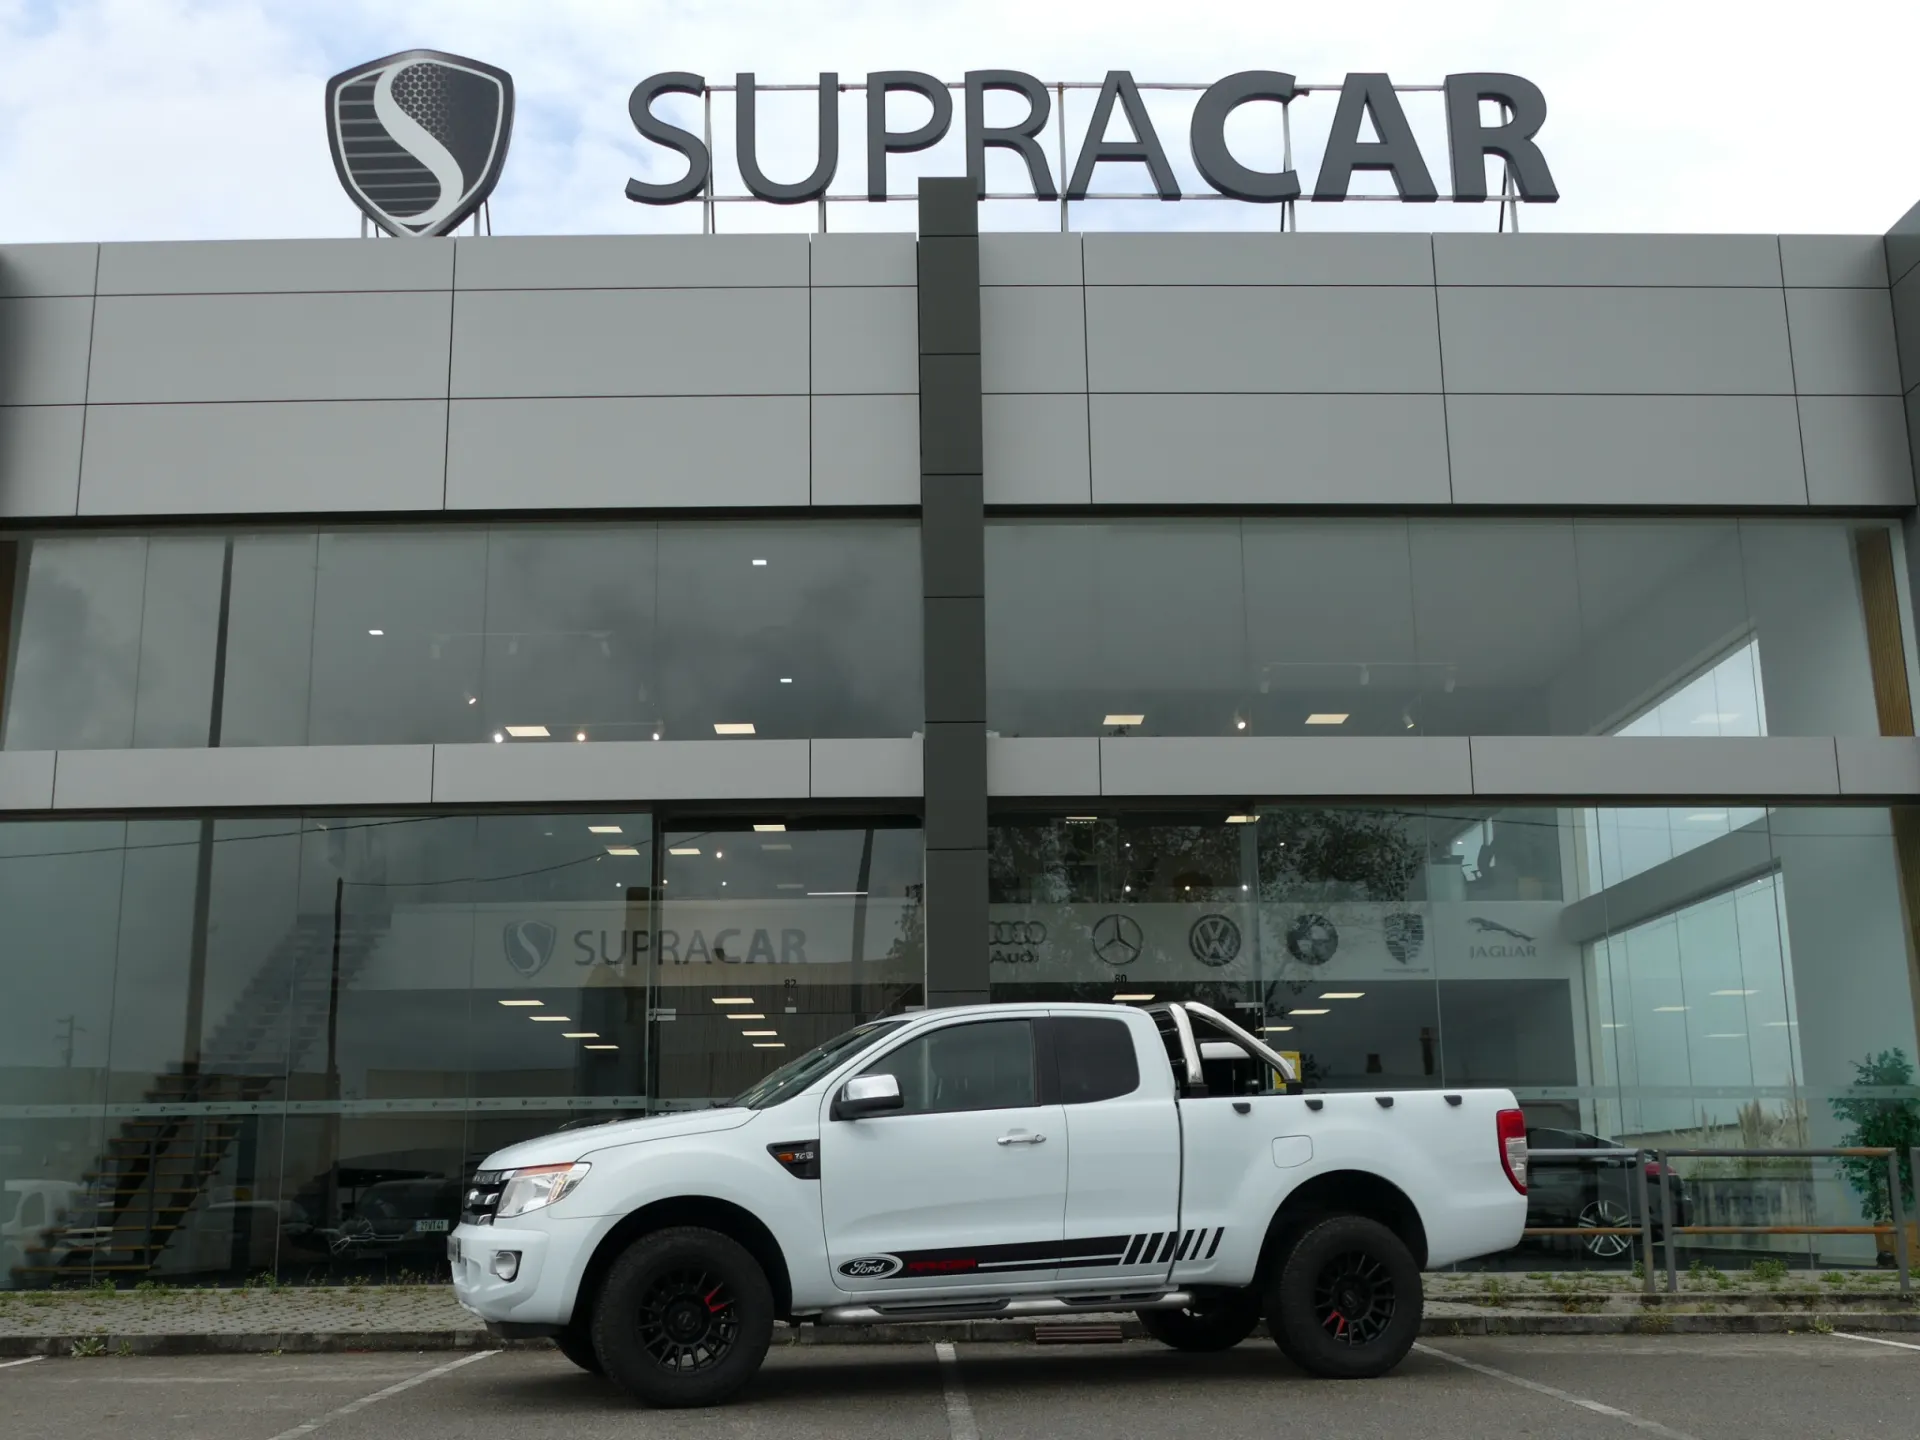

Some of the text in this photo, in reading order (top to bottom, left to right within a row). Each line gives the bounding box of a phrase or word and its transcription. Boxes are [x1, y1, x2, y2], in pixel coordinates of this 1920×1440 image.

[626, 69, 1559, 205] SUPRACAR
[574, 929, 808, 965] SUPRACAR
[1469, 945, 1537, 959] JAGUAR
[784, 979, 798, 988] 82
[850, 1260, 885, 1274] Ford
